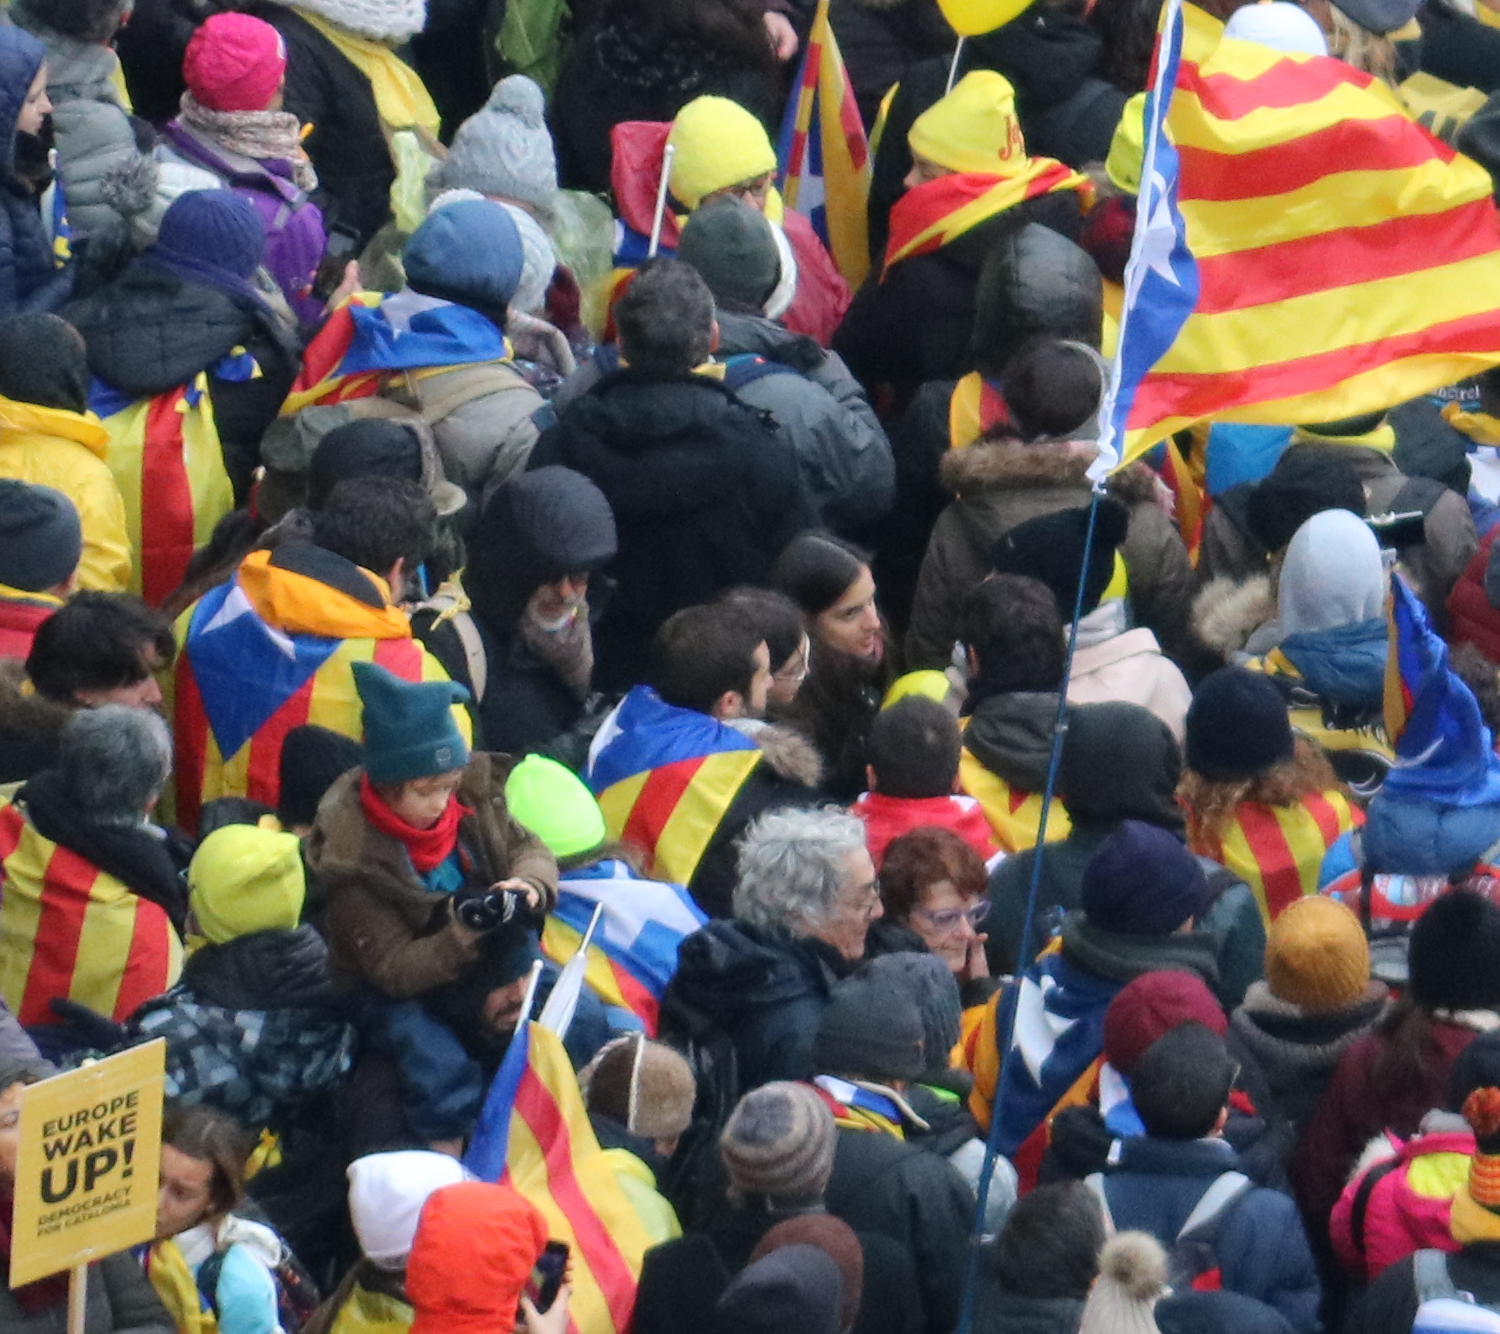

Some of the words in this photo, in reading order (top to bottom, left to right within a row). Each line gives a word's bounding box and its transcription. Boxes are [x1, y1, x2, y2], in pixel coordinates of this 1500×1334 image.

[42, 1089, 140, 1138] EUROPE
[43, 1110, 138, 1162] WAKE
[41, 1139, 137, 1204] UP!
[38, 1184, 133, 1225] DEMOCRACY
[64, 1198, 132, 1227] CATALONIA
